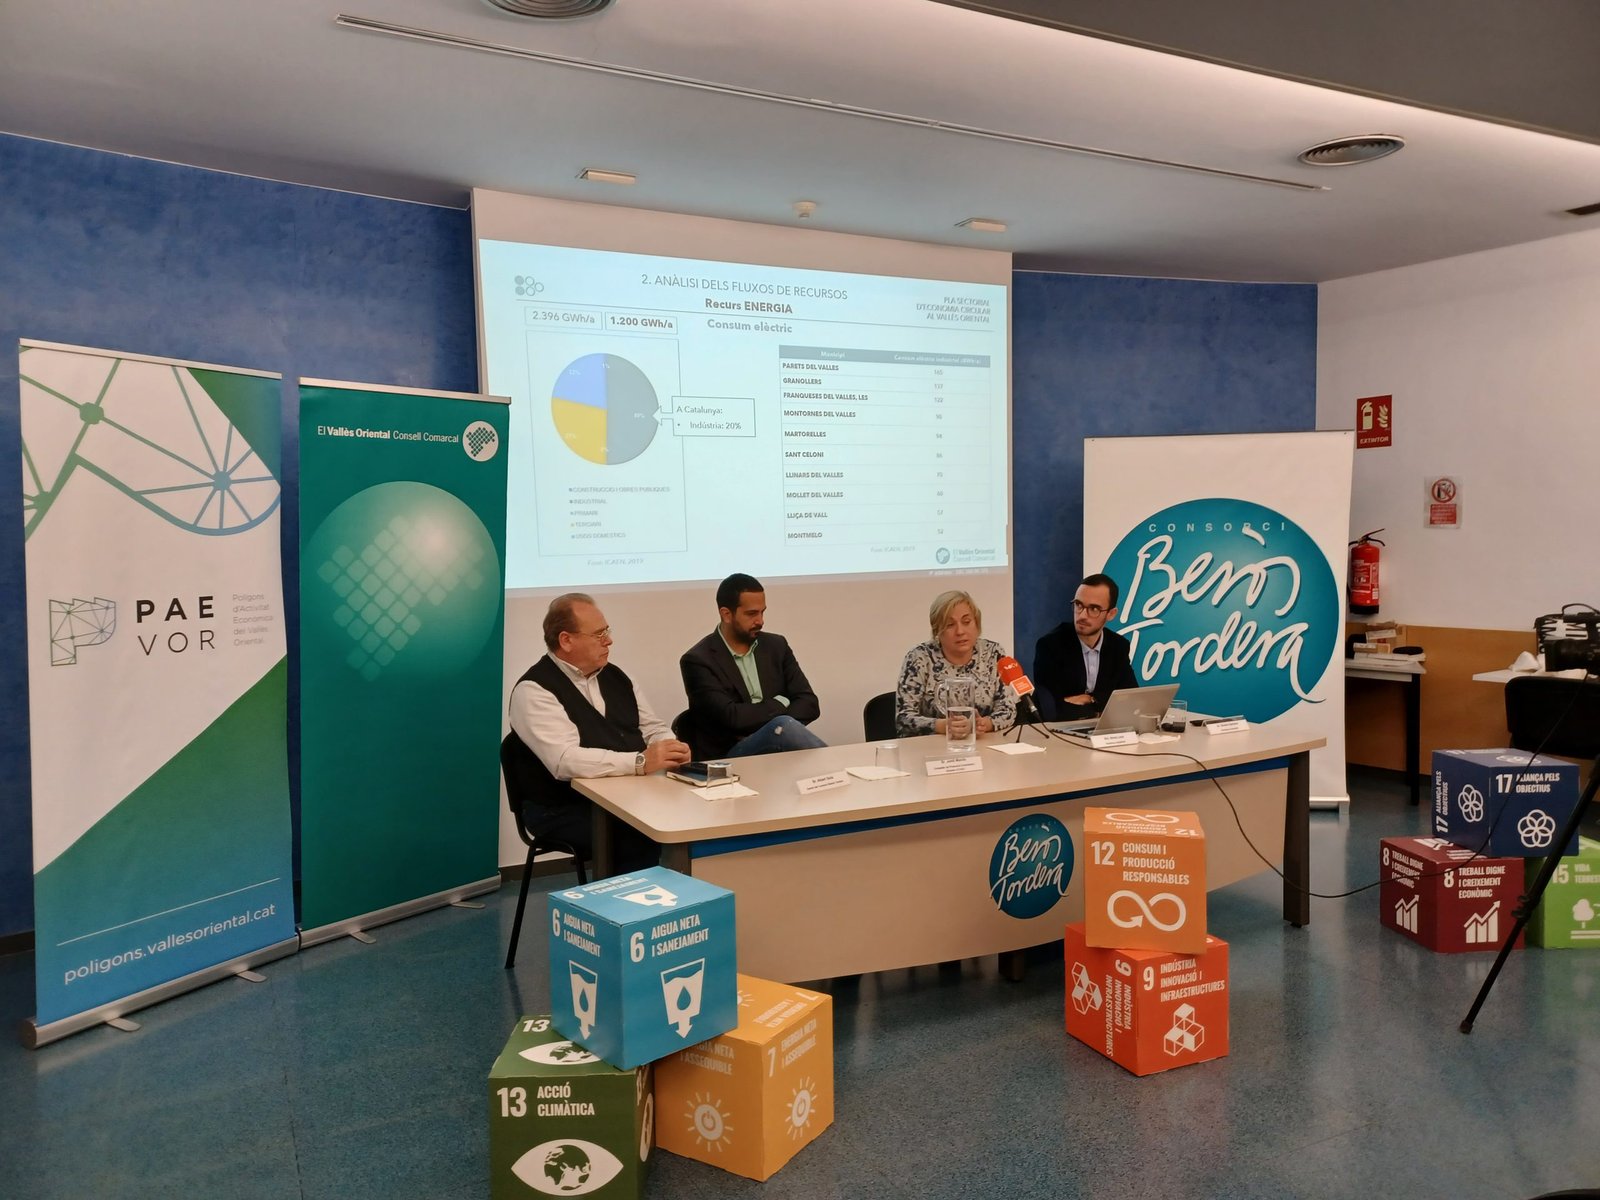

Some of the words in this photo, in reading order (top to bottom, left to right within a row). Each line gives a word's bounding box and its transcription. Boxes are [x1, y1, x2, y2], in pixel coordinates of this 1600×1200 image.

[642, 274, 651, 285] 2.
[655, 274, 699, 289] ANÀLISI
[702, 279, 729, 291] DELS
[732, 282, 774, 295] FLUXOS
[777, 285, 791, 296] DE
[794, 287, 848, 300] RECURSOS
[705, 298, 741, 310] Recurs
[745, 301, 793, 314] ENERGIA
[532, 311, 559, 321] 2.396
[562, 313, 595, 324] GWh/a
[611, 316, 638, 326] 1.200
[641, 318, 673, 329] GWh/a
[707, 319, 751, 331] Consum
[754, 321, 792, 333] elèctric
[783, 377, 822, 385] GRANOLLERS
[783, 392, 823, 400] FRANQUESES
[684, 406, 723, 416] Catalunya:
[784, 410, 823, 418] MONTORNES
[318, 426, 326, 435] El
[327, 426, 355, 437] Vallès
[356, 428, 391, 439] Oriental
[393, 431, 422, 441] Consell
[423, 433, 459, 443] Comarcal
[690, 421, 724, 430] Indústria:
[725, 422, 742, 431] 20%
[1149, 522, 1285, 533] CONSORCI
[136, 596, 215, 623] PAE
[137, 630, 215, 656] VOR
[1116, 611, 1326, 703] Tordera
[1496, 774, 1513, 793] 17
[1545, 773, 1560, 782] PELS
[1516, 784, 1551, 793] OBJECTIUS
[1436, 816, 1448, 833] 17
[1091, 841, 1115, 866] 12
[1122, 843, 1161, 855] CONSUM
[1163, 845, 1167, 855] I
[1383, 848, 1390, 866] 8
[1123, 856, 1175, 870] PRODUCCIÓ
[1123, 871, 1190, 886] RESPONSABLES
[1444, 868, 1455, 888] 8
[1459, 867, 1485, 876] TREBALL
[1486, 866, 1506, 875] DIGNE
[1462, 877, 1501, 887] CREIXEMENT
[989, 862, 1069, 910] Tordera
[1459, 887, 1493, 899] ECONÒMIC
[563, 891, 585, 899] 6
[552, 908, 561, 937] 6
[564, 913, 581, 931] AIGUA
[581, 920, 595, 937] NETA
[64, 904, 276, 985] poligons.vallesoriental.cat
[566, 930, 600, 957] SANEIAMENT
[630, 932, 645, 963] 6
[651, 922, 679, 940] AIGUA
[680, 914, 700, 932] NETA
[657, 928, 709, 956] SANEIAMENT
[1143, 966, 1155, 991] 9
[1160, 959, 1196, 974] INDÚSTRIA
[1160, 971, 1197, 988] INNOVACIÓ
[1115, 959, 1132, 977] 9
[1124, 984, 1132, 1030] INDÚSTRIA
[1160, 980, 1225, 1002] INFRAESTRUCTURES
[522, 1019, 550, 1033] 13
[715, 1043, 734, 1059] NETA
[685, 1052, 732, 1075] ASSEQUIBLE
[768, 1047, 776, 1077] 7
[497, 1087, 527, 1118] 13
[537, 1082, 571, 1099] ACCIÓ
[537, 1100, 595, 1117] CLIMÀTICA
